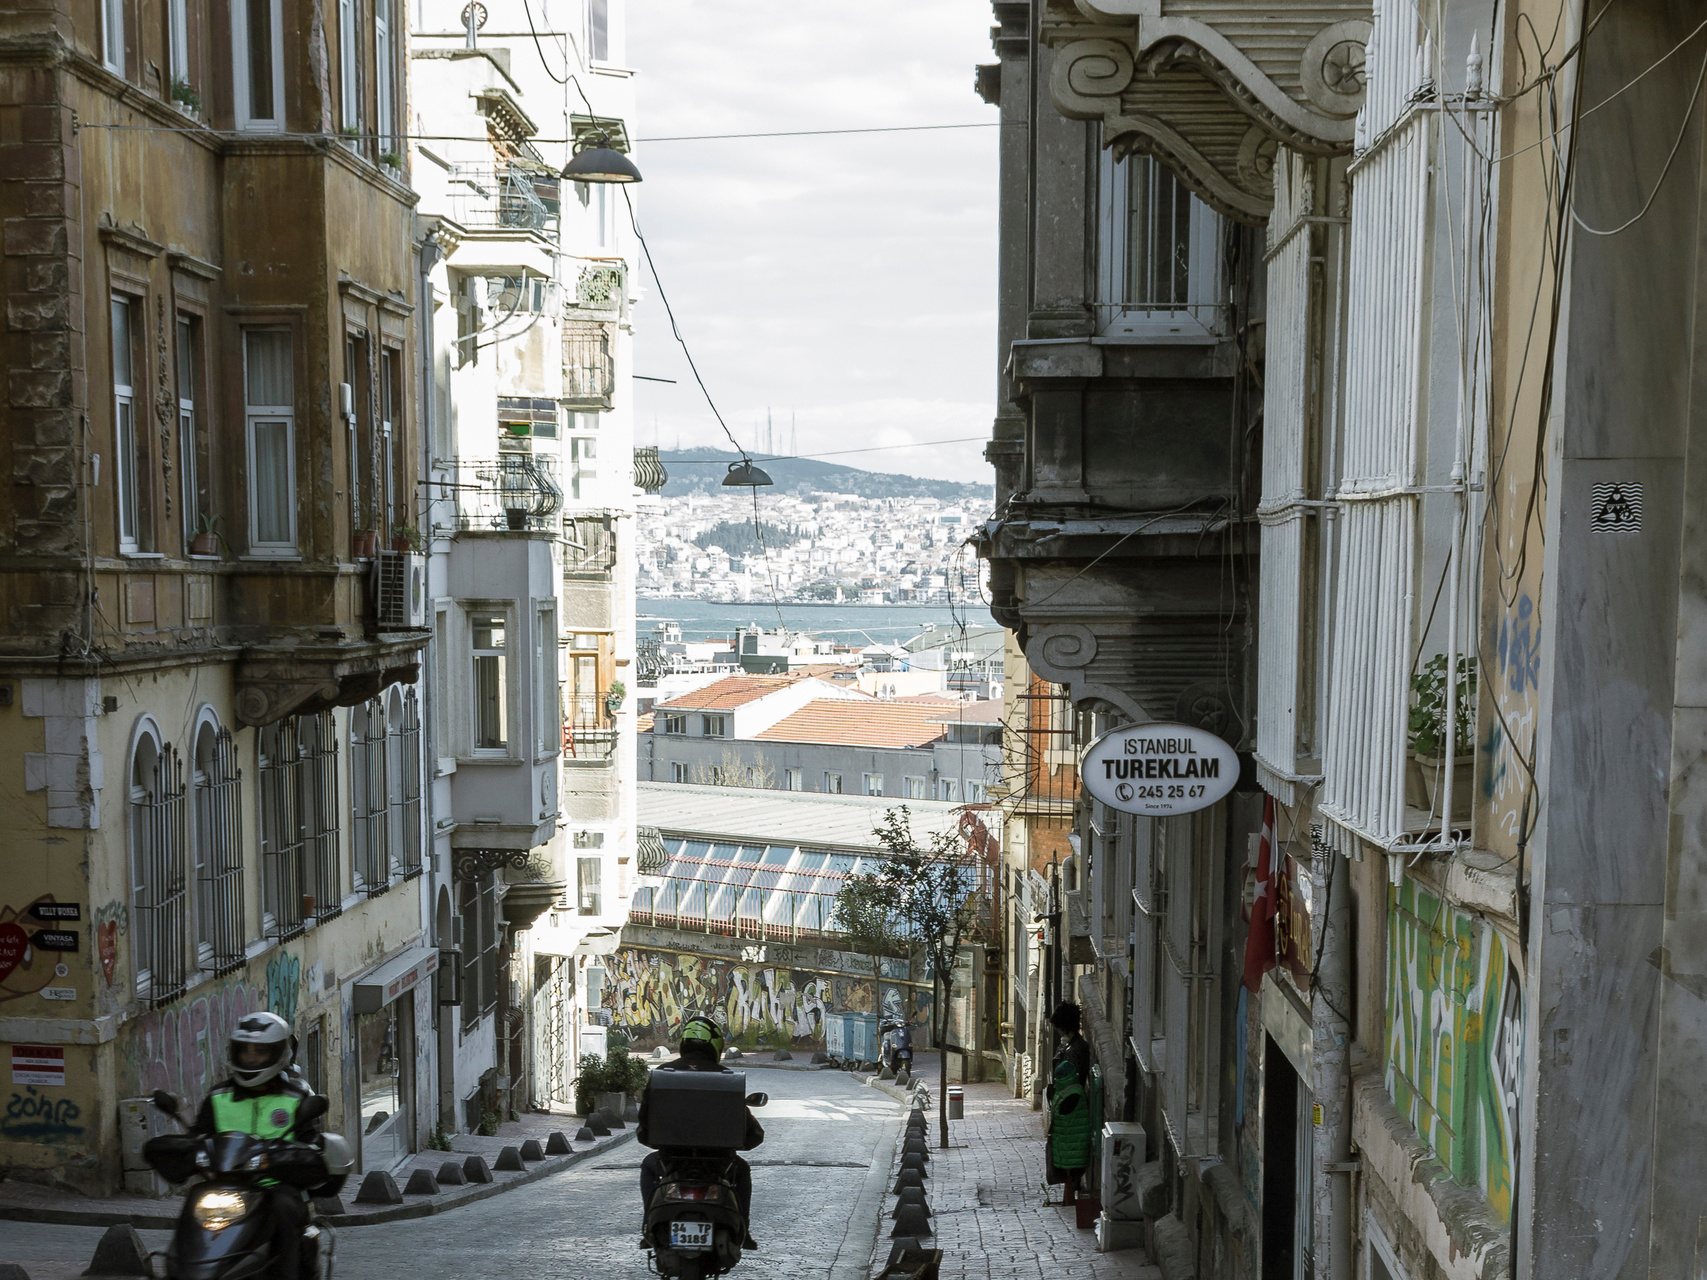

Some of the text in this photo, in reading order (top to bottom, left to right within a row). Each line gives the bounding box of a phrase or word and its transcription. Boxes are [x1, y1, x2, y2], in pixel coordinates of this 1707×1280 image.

[1102, 758, 1219, 779] TUREKLAM
[1138, 785, 1205, 799] 245 25 67
[43, 934, 74, 942] VINYASA
[672, 1223, 711, 1234] 34 TP
[680, 1234, 707, 1244] 3189
